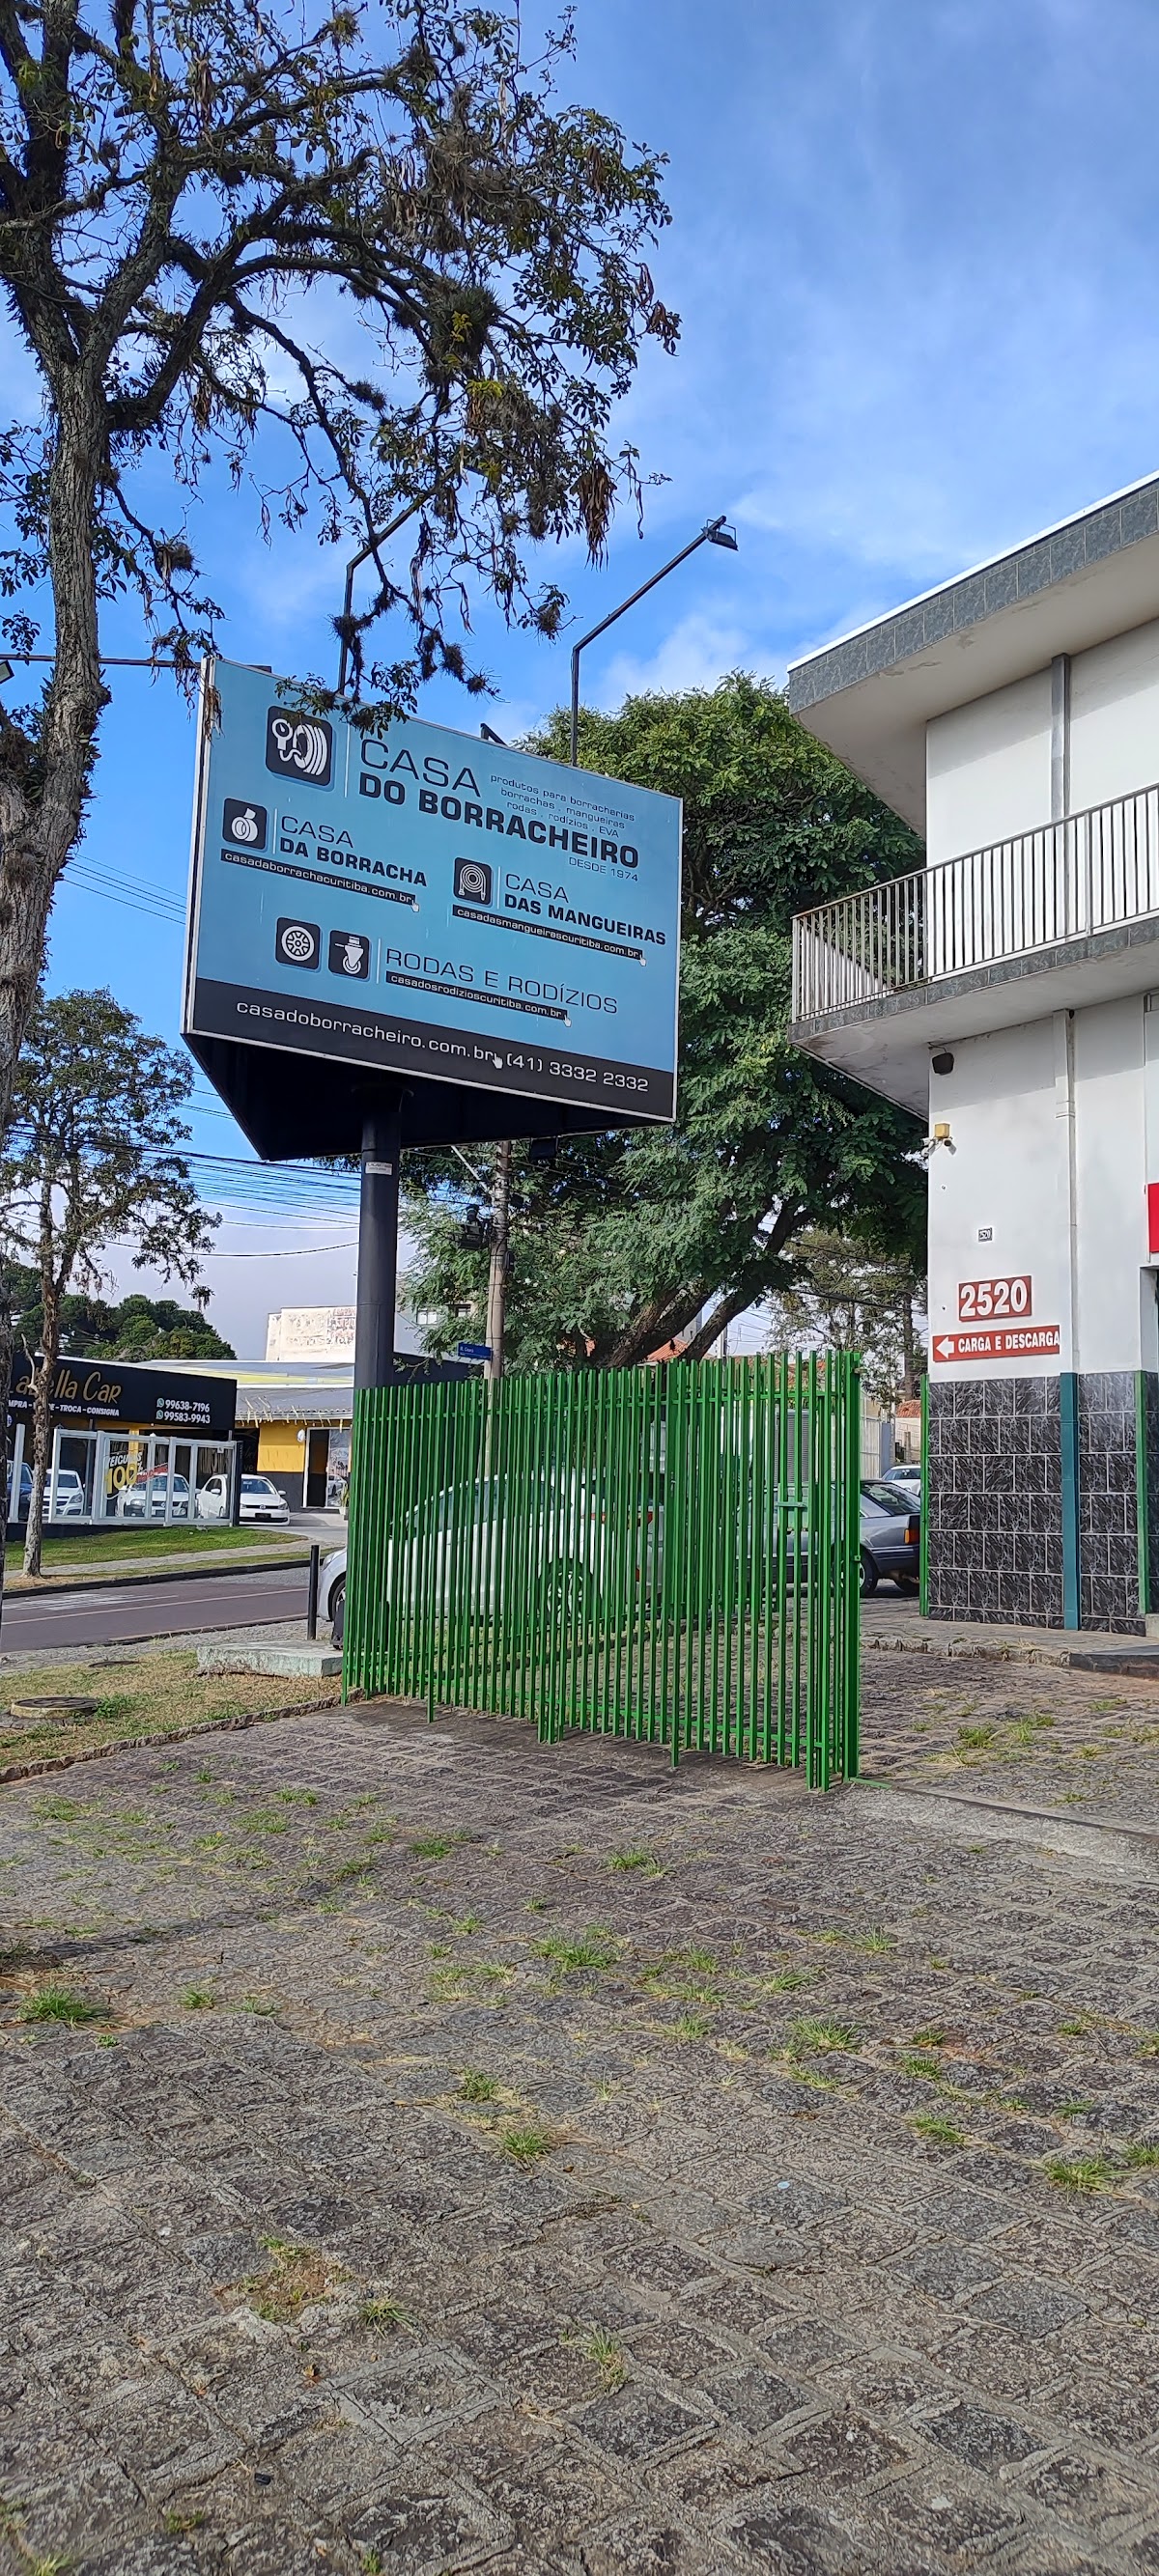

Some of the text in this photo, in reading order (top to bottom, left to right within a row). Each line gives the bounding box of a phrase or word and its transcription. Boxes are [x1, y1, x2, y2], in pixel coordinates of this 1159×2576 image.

[360, 739, 481, 798] CASA
[491, 774, 635, 822] produtos para borracharias
[500, 787, 625, 829] borrachas mangueiras
[506, 800, 619, 838] rodas rodízios EVA
[281, 816, 353, 848] CASA
[359, 772, 639, 868] DO BORRACHEIRO
[224, 852, 412, 904] casadaborrachacuritiba.com.br
[280, 837, 428, 886] DA BORRACHA
[569, 856, 638, 882] DESDE 1974
[505, 873, 570, 904] CASA
[457, 908, 639, 958] casadasmangueirascuritiba.com.br
[504, 893, 666, 945] DAS MANGUEIRAS
[386, 948, 618, 1014] RODAS E RODÍZIOS
[391, 974, 562, 1019] casadosrodizioscuritiba.com.br
[236, 1001, 649, 1092] casadoborracheiro.com.br (41) 3332 2332
[960, 1279, 1028, 1317] 2520
[958, 1330, 1060, 1353] CARGA E DESCARGA
[59, 1405, 82, 1414] TROCA
[87, 1407, 120, 1416] CONSIGNA
[164, 1411, 211, 1424] 99583-9943
[165, 1399, 211, 1413] 99638-7196
